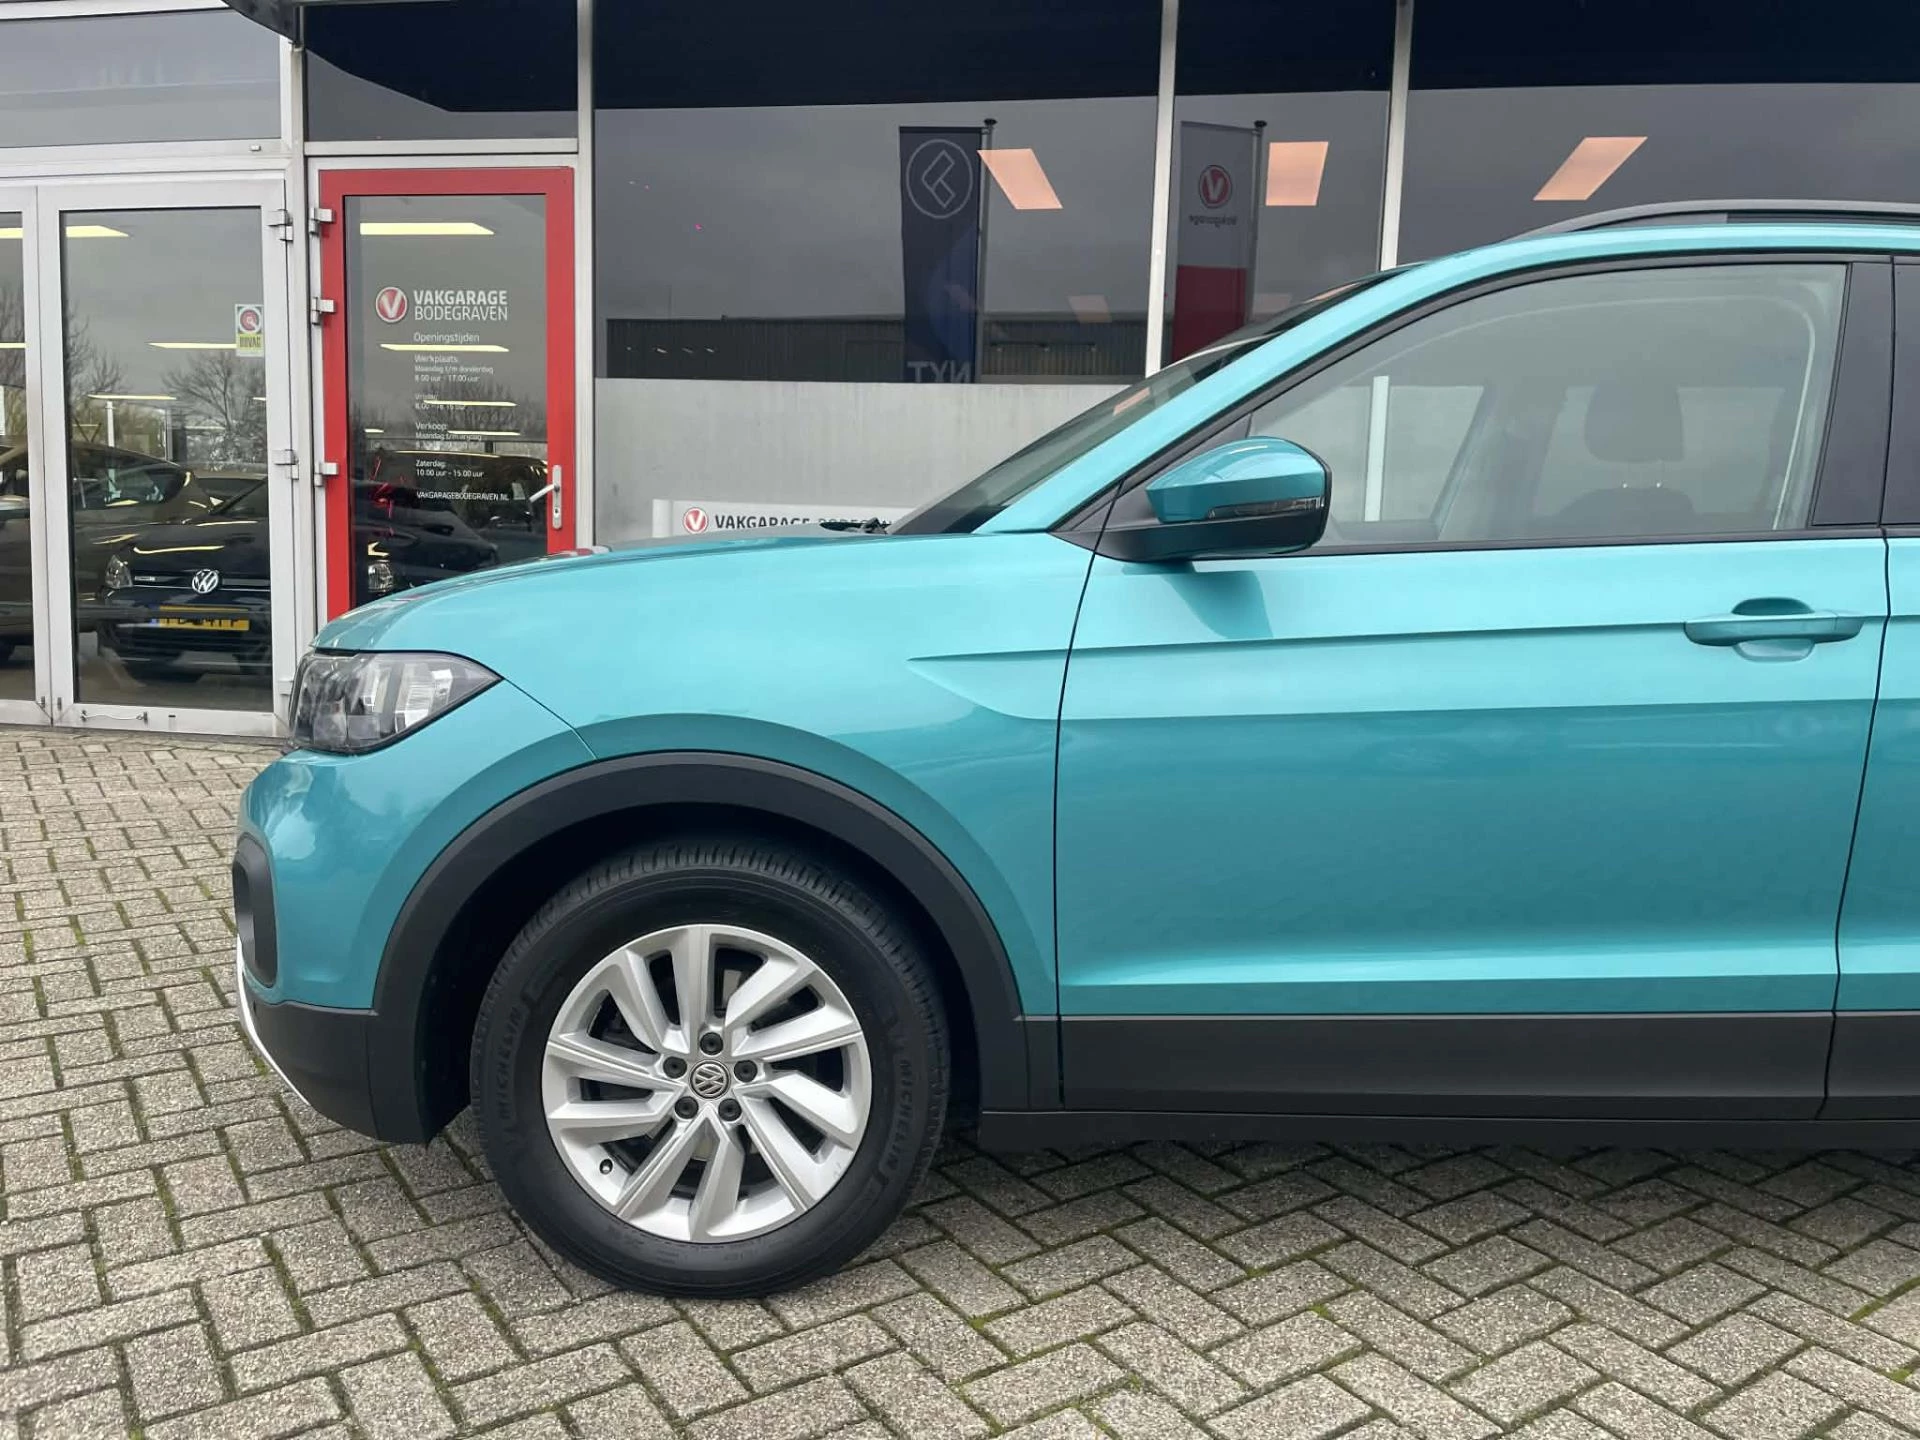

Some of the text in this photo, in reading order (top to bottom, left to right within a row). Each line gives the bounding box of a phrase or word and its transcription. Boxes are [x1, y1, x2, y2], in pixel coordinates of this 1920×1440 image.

[413, 290, 508, 305] VAKGARAGE
[414, 305, 508, 321] BODEGRAVEN
[413, 331, 480, 343] Openingstijden
